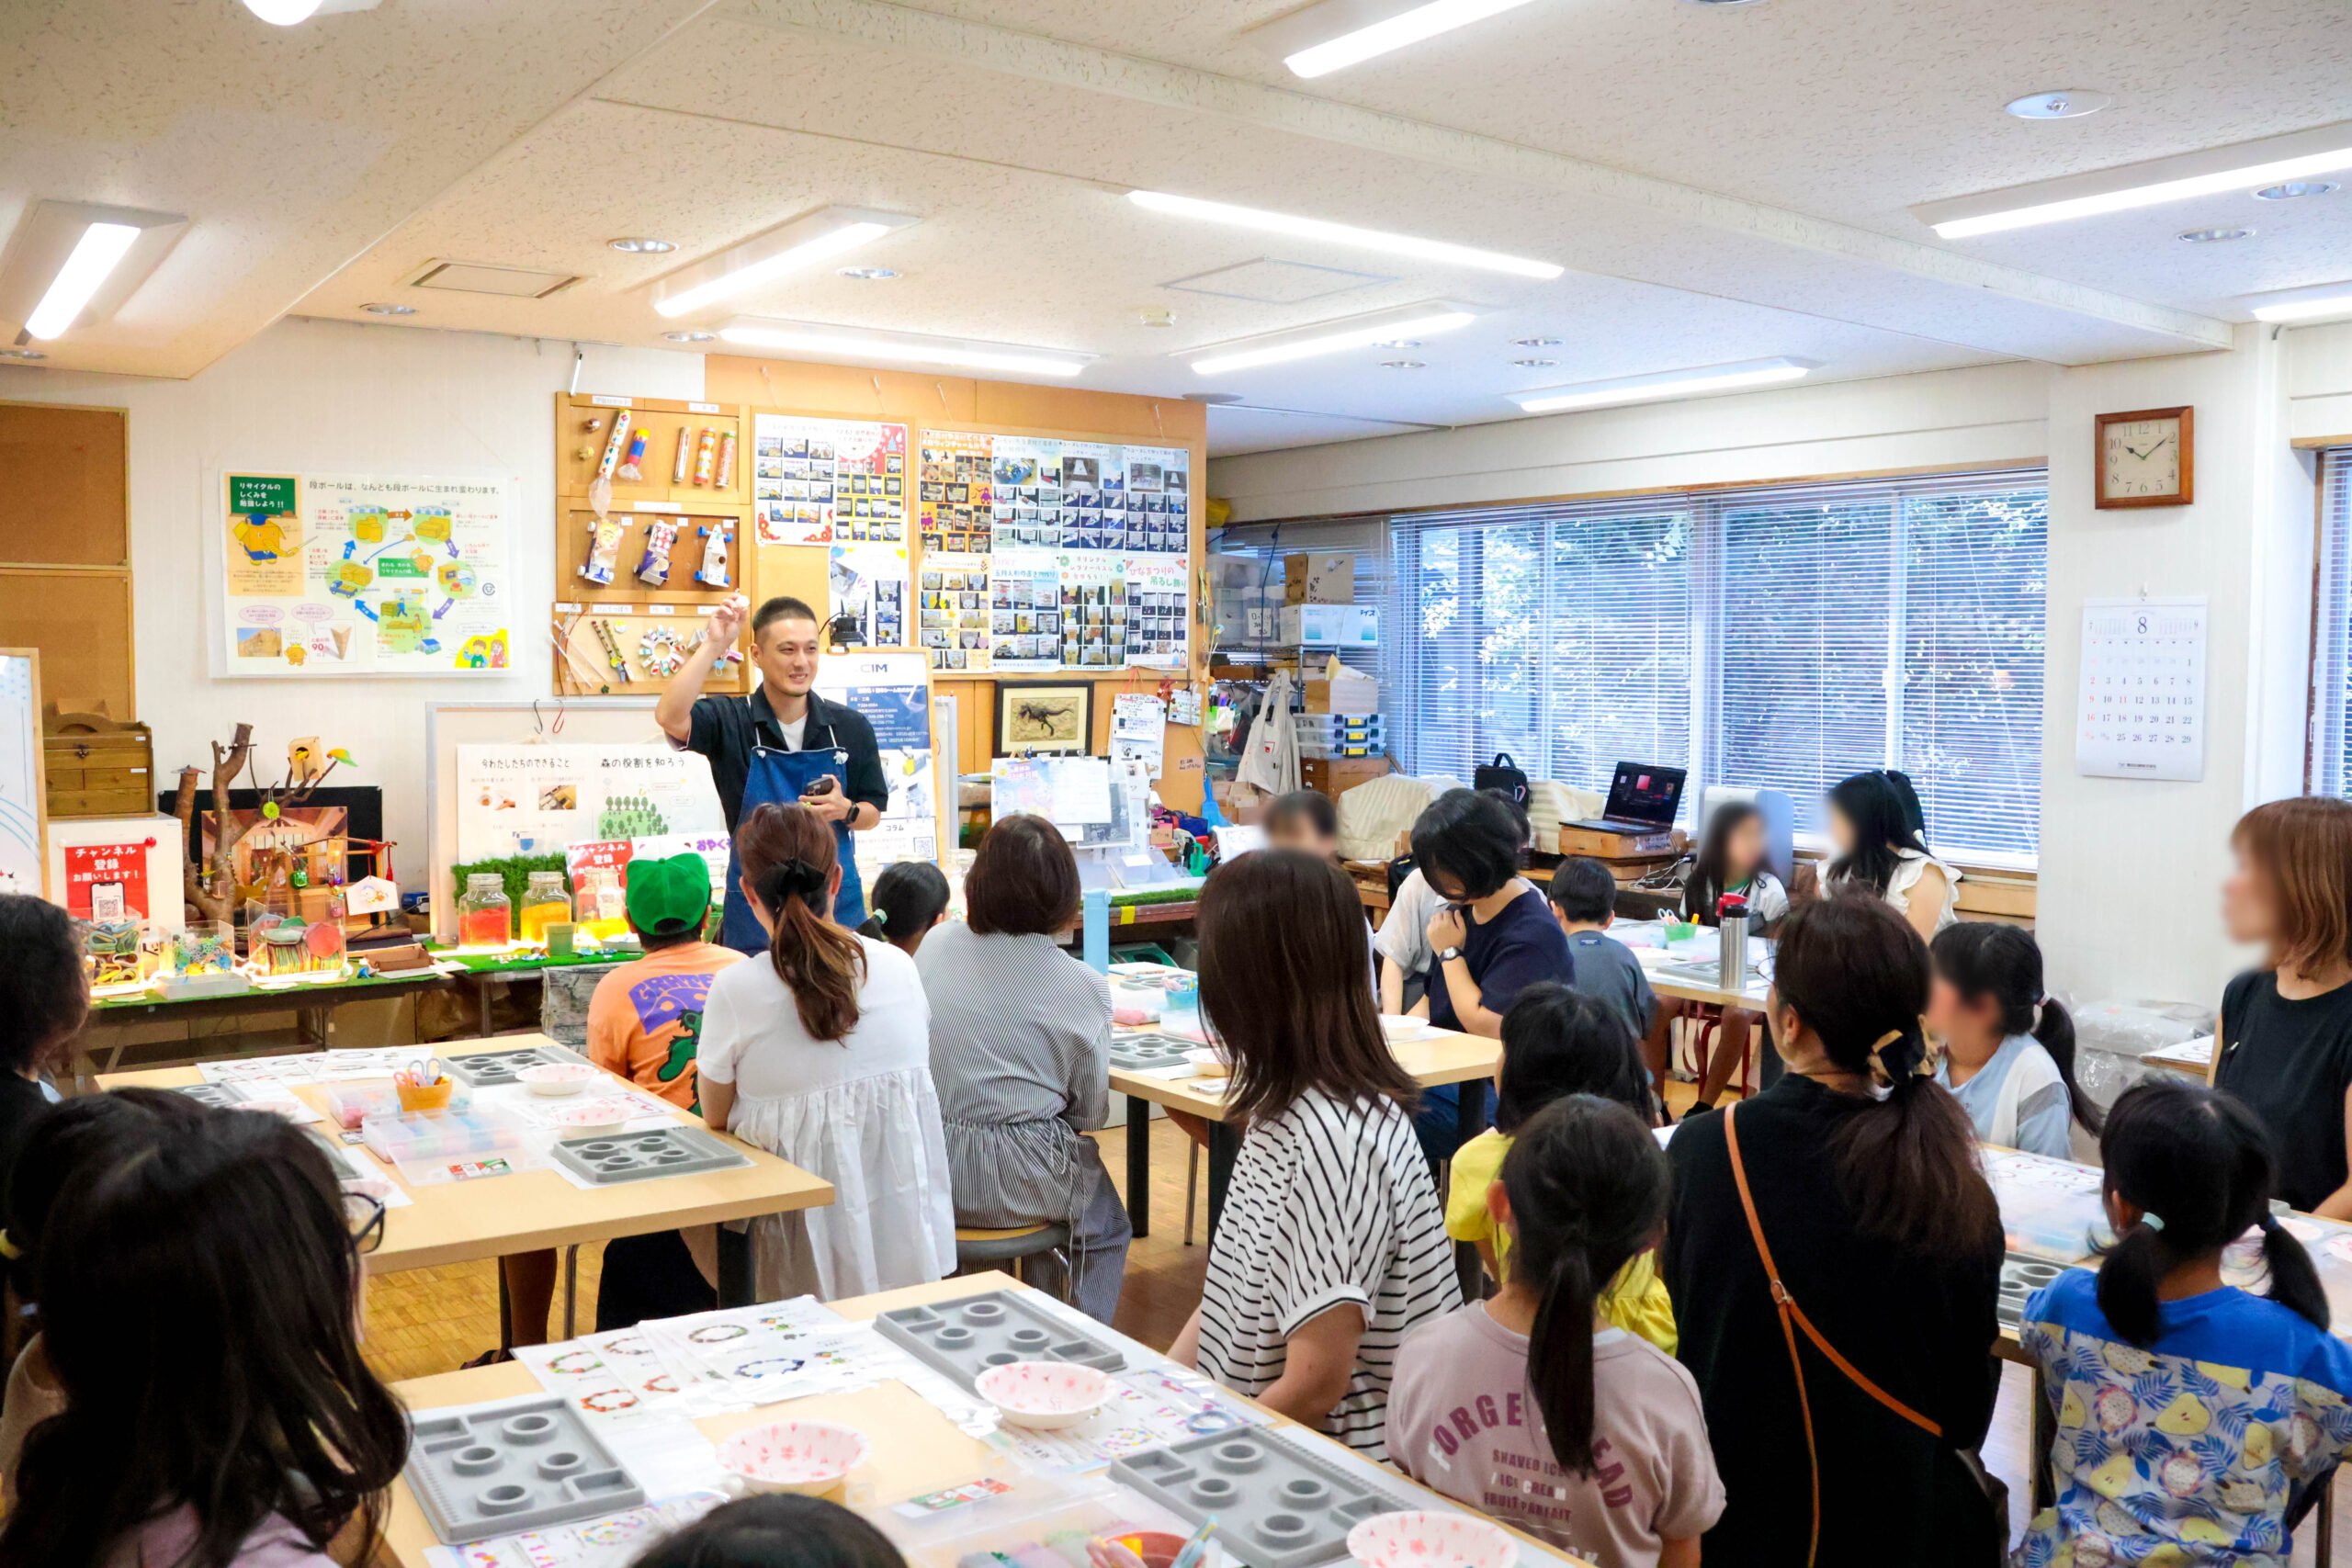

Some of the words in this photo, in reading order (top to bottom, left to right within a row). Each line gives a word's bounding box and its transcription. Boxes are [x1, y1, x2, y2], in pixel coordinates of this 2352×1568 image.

[2123, 425, 2132, 437] 11
[2138, 423, 2150, 434] 12
[2157, 422, 2162, 434] 1
[2109, 437, 2122, 450] 10
[2169, 431, 2177, 444] 2
[2109, 455, 2118, 466] 9
[2169, 449, 2177, 463] 3
[2112, 472, 2120, 485] 8
[2167, 468, 2177, 480] 4
[239, 482, 281, 491] リサイクルの
[2125, 481, 2132, 493] 7
[2140, 482, 2148, 493] 6
[2154, 479, 2163, 493] 5
[1129, 566, 1175, 576] ひなまつりの
[2137, 615, 2148, 635] 8
[2187, 659, 2191, 667] 1
[2107, 677, 2111, 685] 3
[2123, 677, 2127, 685] 4
[2138, 677, 2143, 685] 5
[2154, 677, 2159, 685] 6
[2170, 677, 2176, 685] 7
[2187, 677, 2191, 685] 8
[2089, 695, 2095, 704] 9
[2104, 695, 2112, 704] 10
[2120, 695, 2127, 704] 11
[2135, 696, 2143, 705] 12
[2151, 696, 2160, 705] 13
[2167, 696, 2176, 705] 14
[2184, 697, 2193, 705] 15
[2086, 714, 2096, 722] 16
[2103, 714, 2111, 722] 17
[2134, 715, 2143, 723] 19
[2150, 716, 2159, 724] 20
[2165, 716, 2175, 724] 21
[2183, 716, 2192, 725] 22
[2117, 733, 2126, 741] 25
[2132, 734, 2143, 742] 26
[2148, 734, 2158, 742] 27
[2165, 735, 2175, 743] 28
[2181, 736, 2191, 744] 29
[481, 758, 571, 769] 今わたしたちのできること
[600, 758, 685, 769] 森の役割を知ろう
[74, 845, 138, 858] チャンネル
[93, 858, 120, 871] 登録
[592, 854, 615, 864] 登録
[74, 869, 139, 882] お願いします!
[1428, 1392, 1522, 1472] FORGE
[1492, 1449, 1541, 1472] SHAVED
[1499, 1473, 1520, 1489] ICE
[1522, 1479, 1566, 1502] CREAM
[1484, 1491, 1518, 1510] FRUIT
